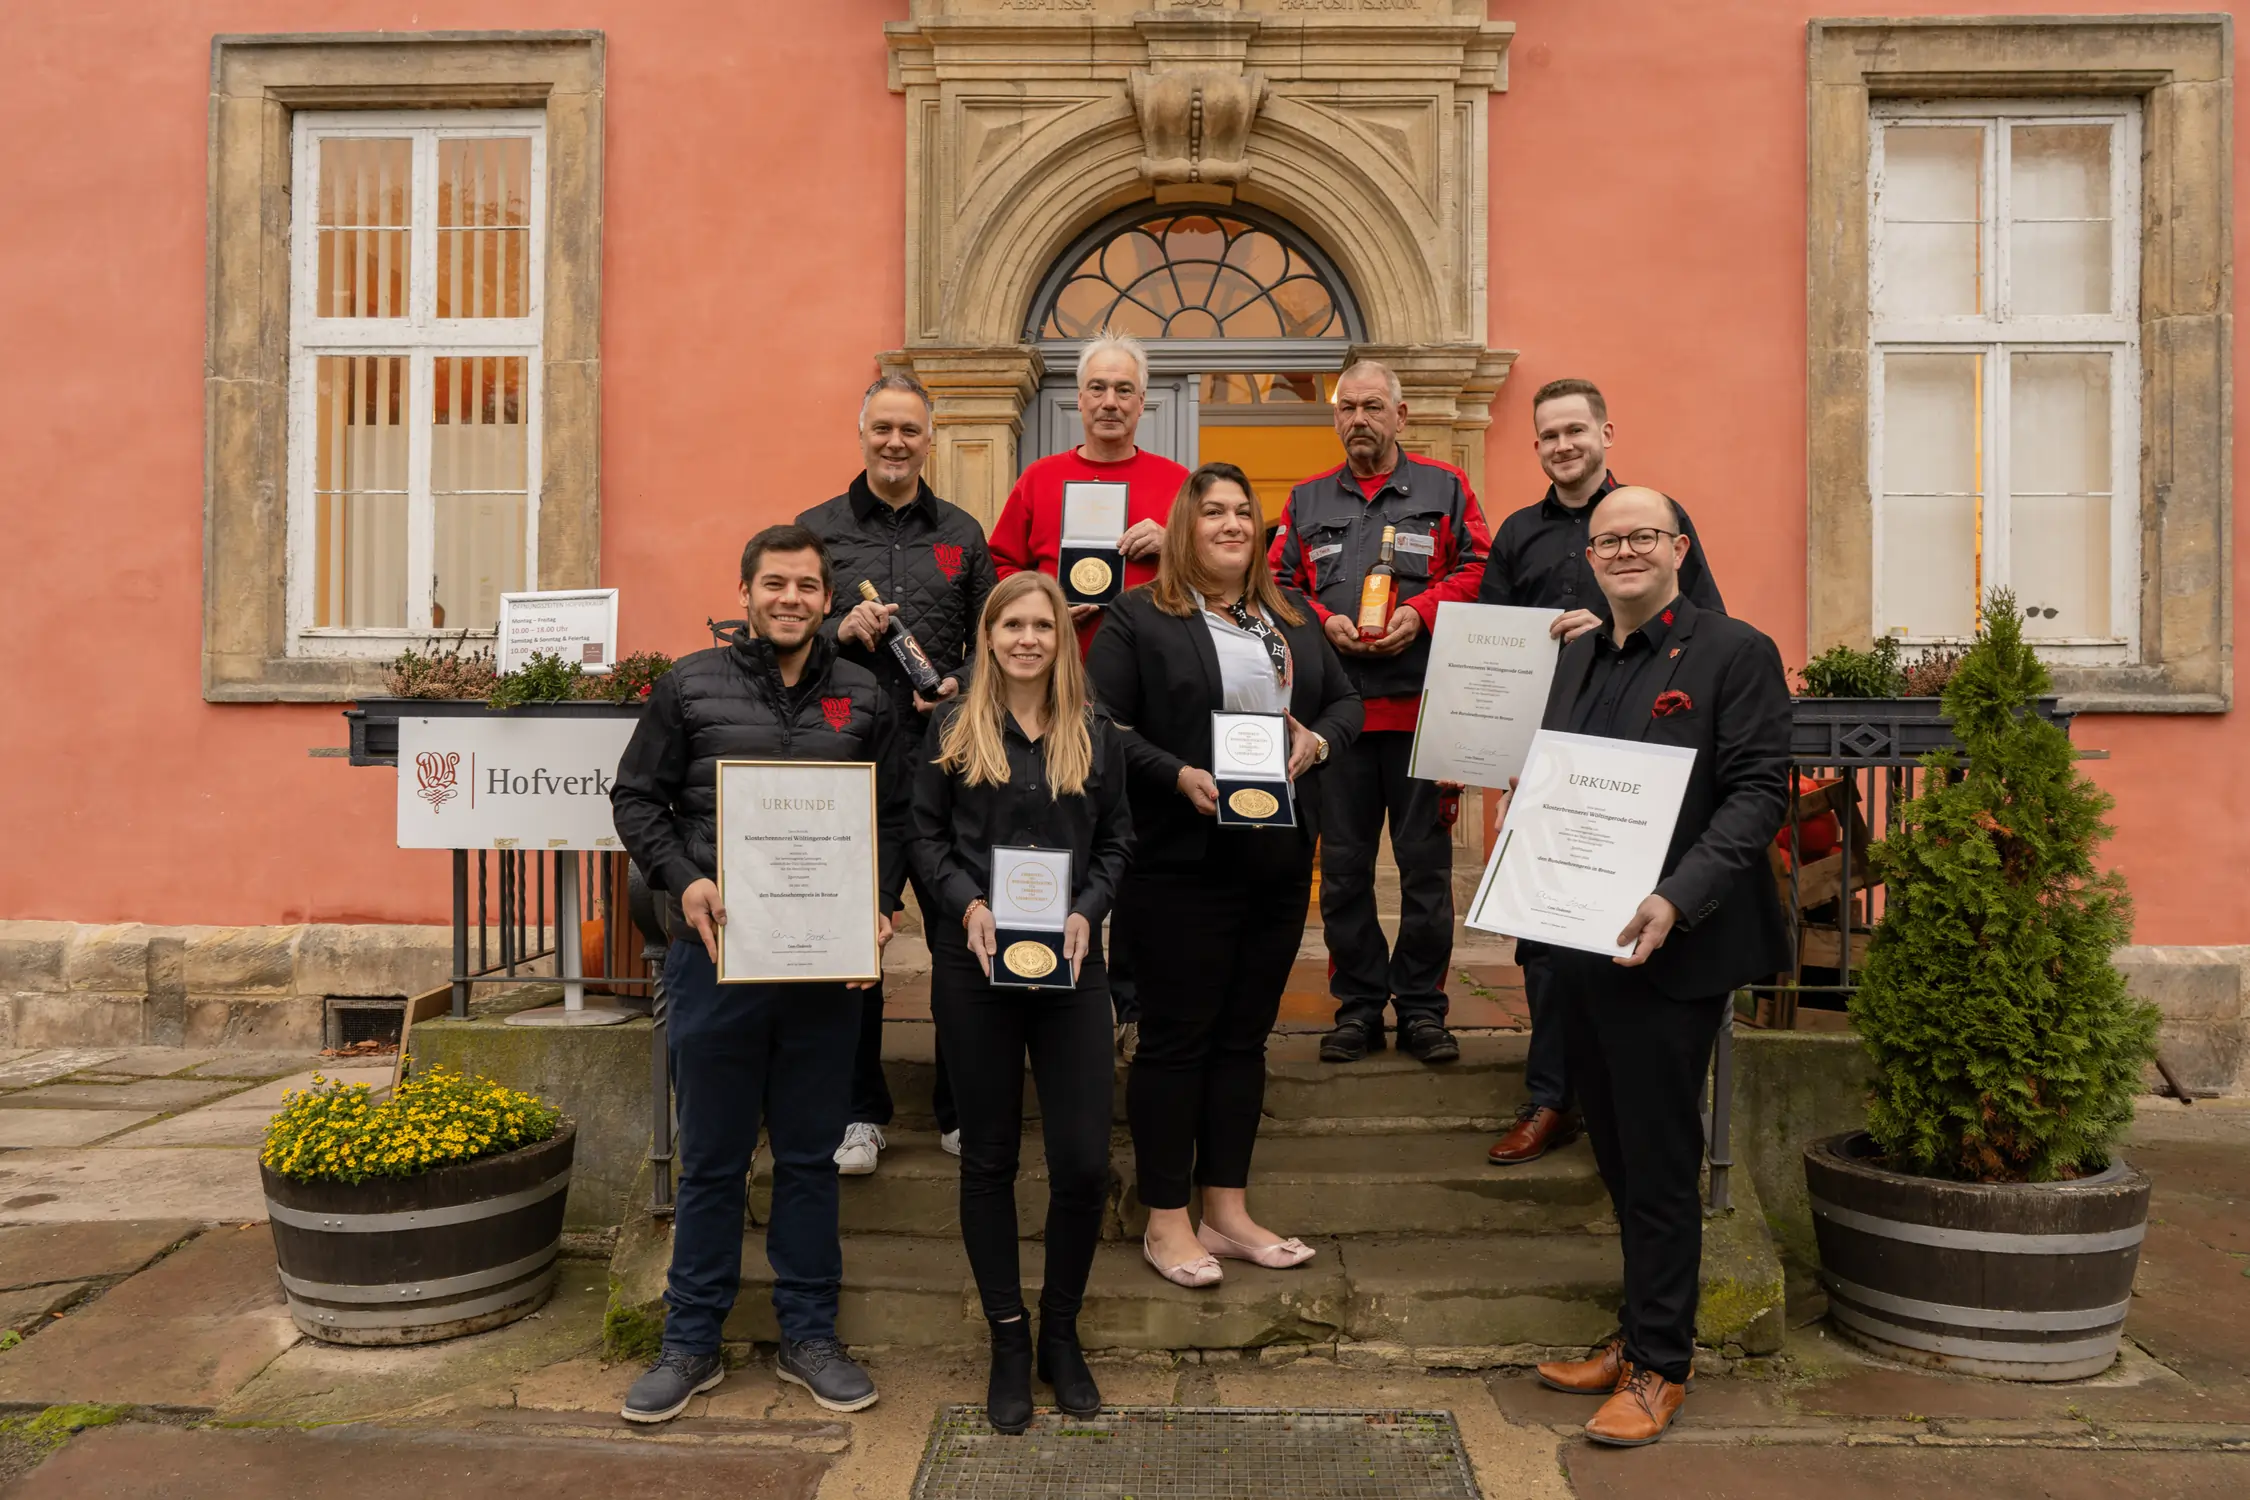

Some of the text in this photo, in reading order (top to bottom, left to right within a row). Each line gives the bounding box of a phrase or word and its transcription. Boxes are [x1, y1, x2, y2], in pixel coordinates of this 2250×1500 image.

[1467, 633, 1527, 648] URKUNDE
[510, 647, 529, 655] 10.00
[1569, 773, 1642, 795] URKUNDE
[762, 798, 835, 811] URKUNDE
[1628, 817, 1648, 827] GmbH
[832, 834, 852, 842] GmbH
